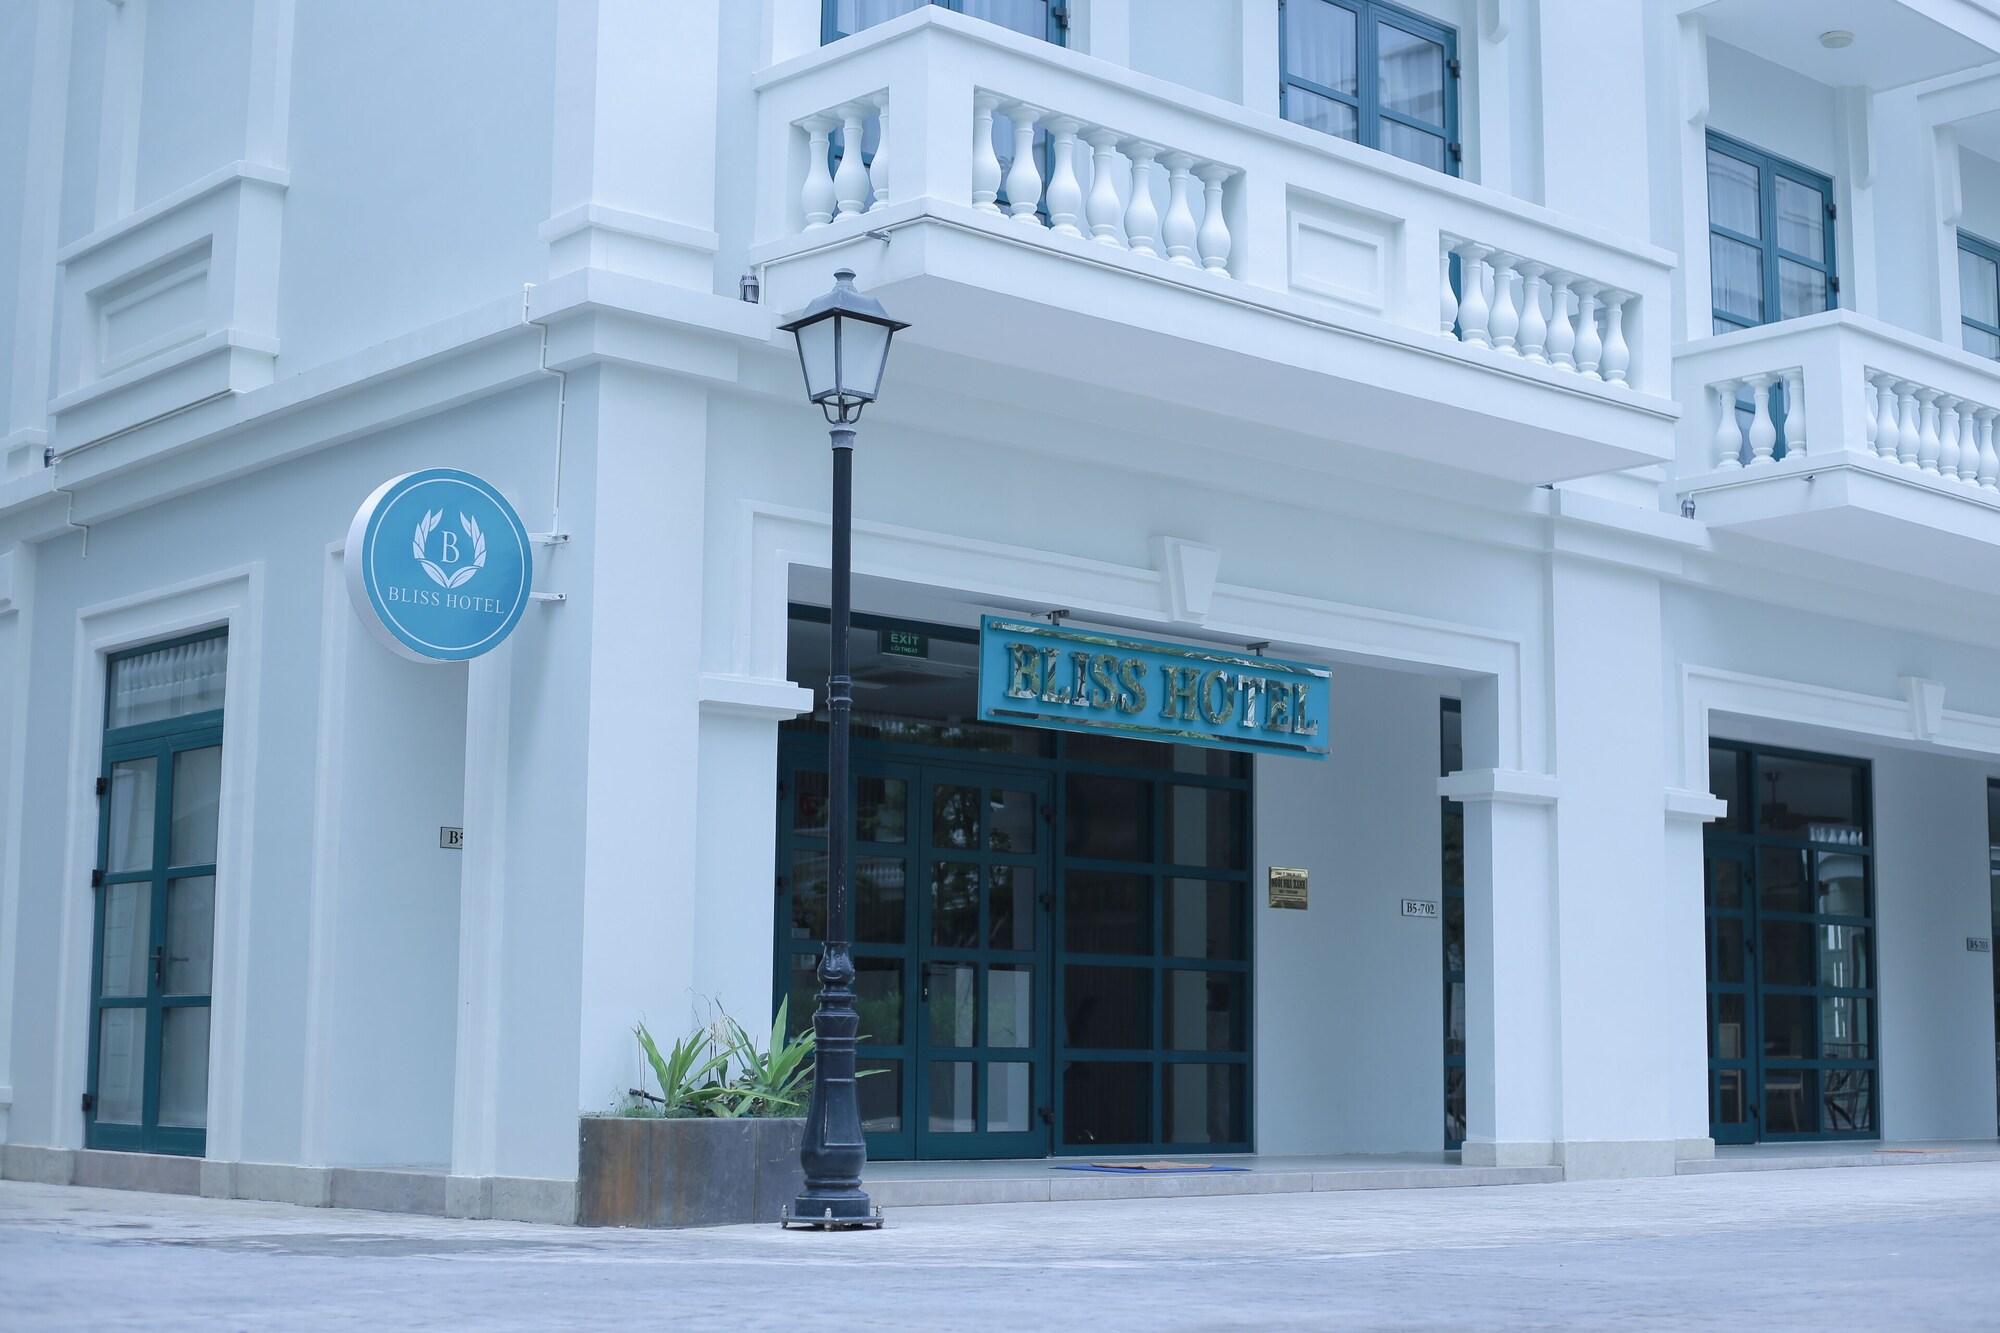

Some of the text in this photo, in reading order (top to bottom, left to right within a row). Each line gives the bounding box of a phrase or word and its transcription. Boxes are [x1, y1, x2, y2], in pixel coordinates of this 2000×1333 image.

[440, 531, 460, 563] B
[389, 586, 505, 614] BLISS HOTEL
[890, 633, 920, 645] EXIT
[1004, 642, 1318, 736] BLISS HOTEL
[1407, 902, 1435, 914] B5-702
